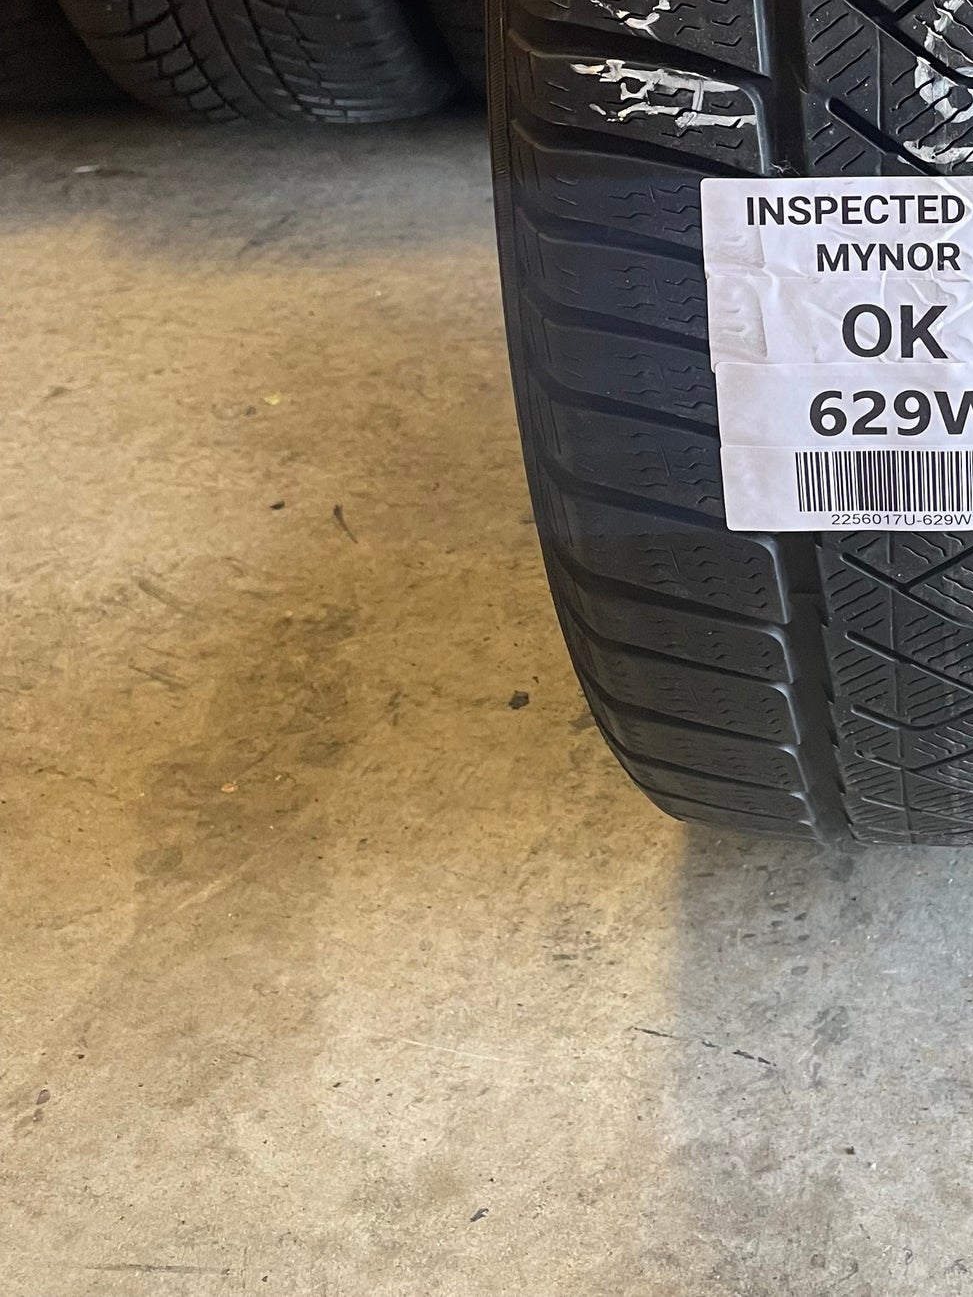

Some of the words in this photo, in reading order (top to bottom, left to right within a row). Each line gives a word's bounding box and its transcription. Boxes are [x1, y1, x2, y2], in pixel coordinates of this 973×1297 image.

[746, 194, 966, 227] INSPECTED
[816, 242, 962, 273] MYNOR
[841, 303, 949, 360] OK
[830, 512, 973, 527] 2256017U-629W
